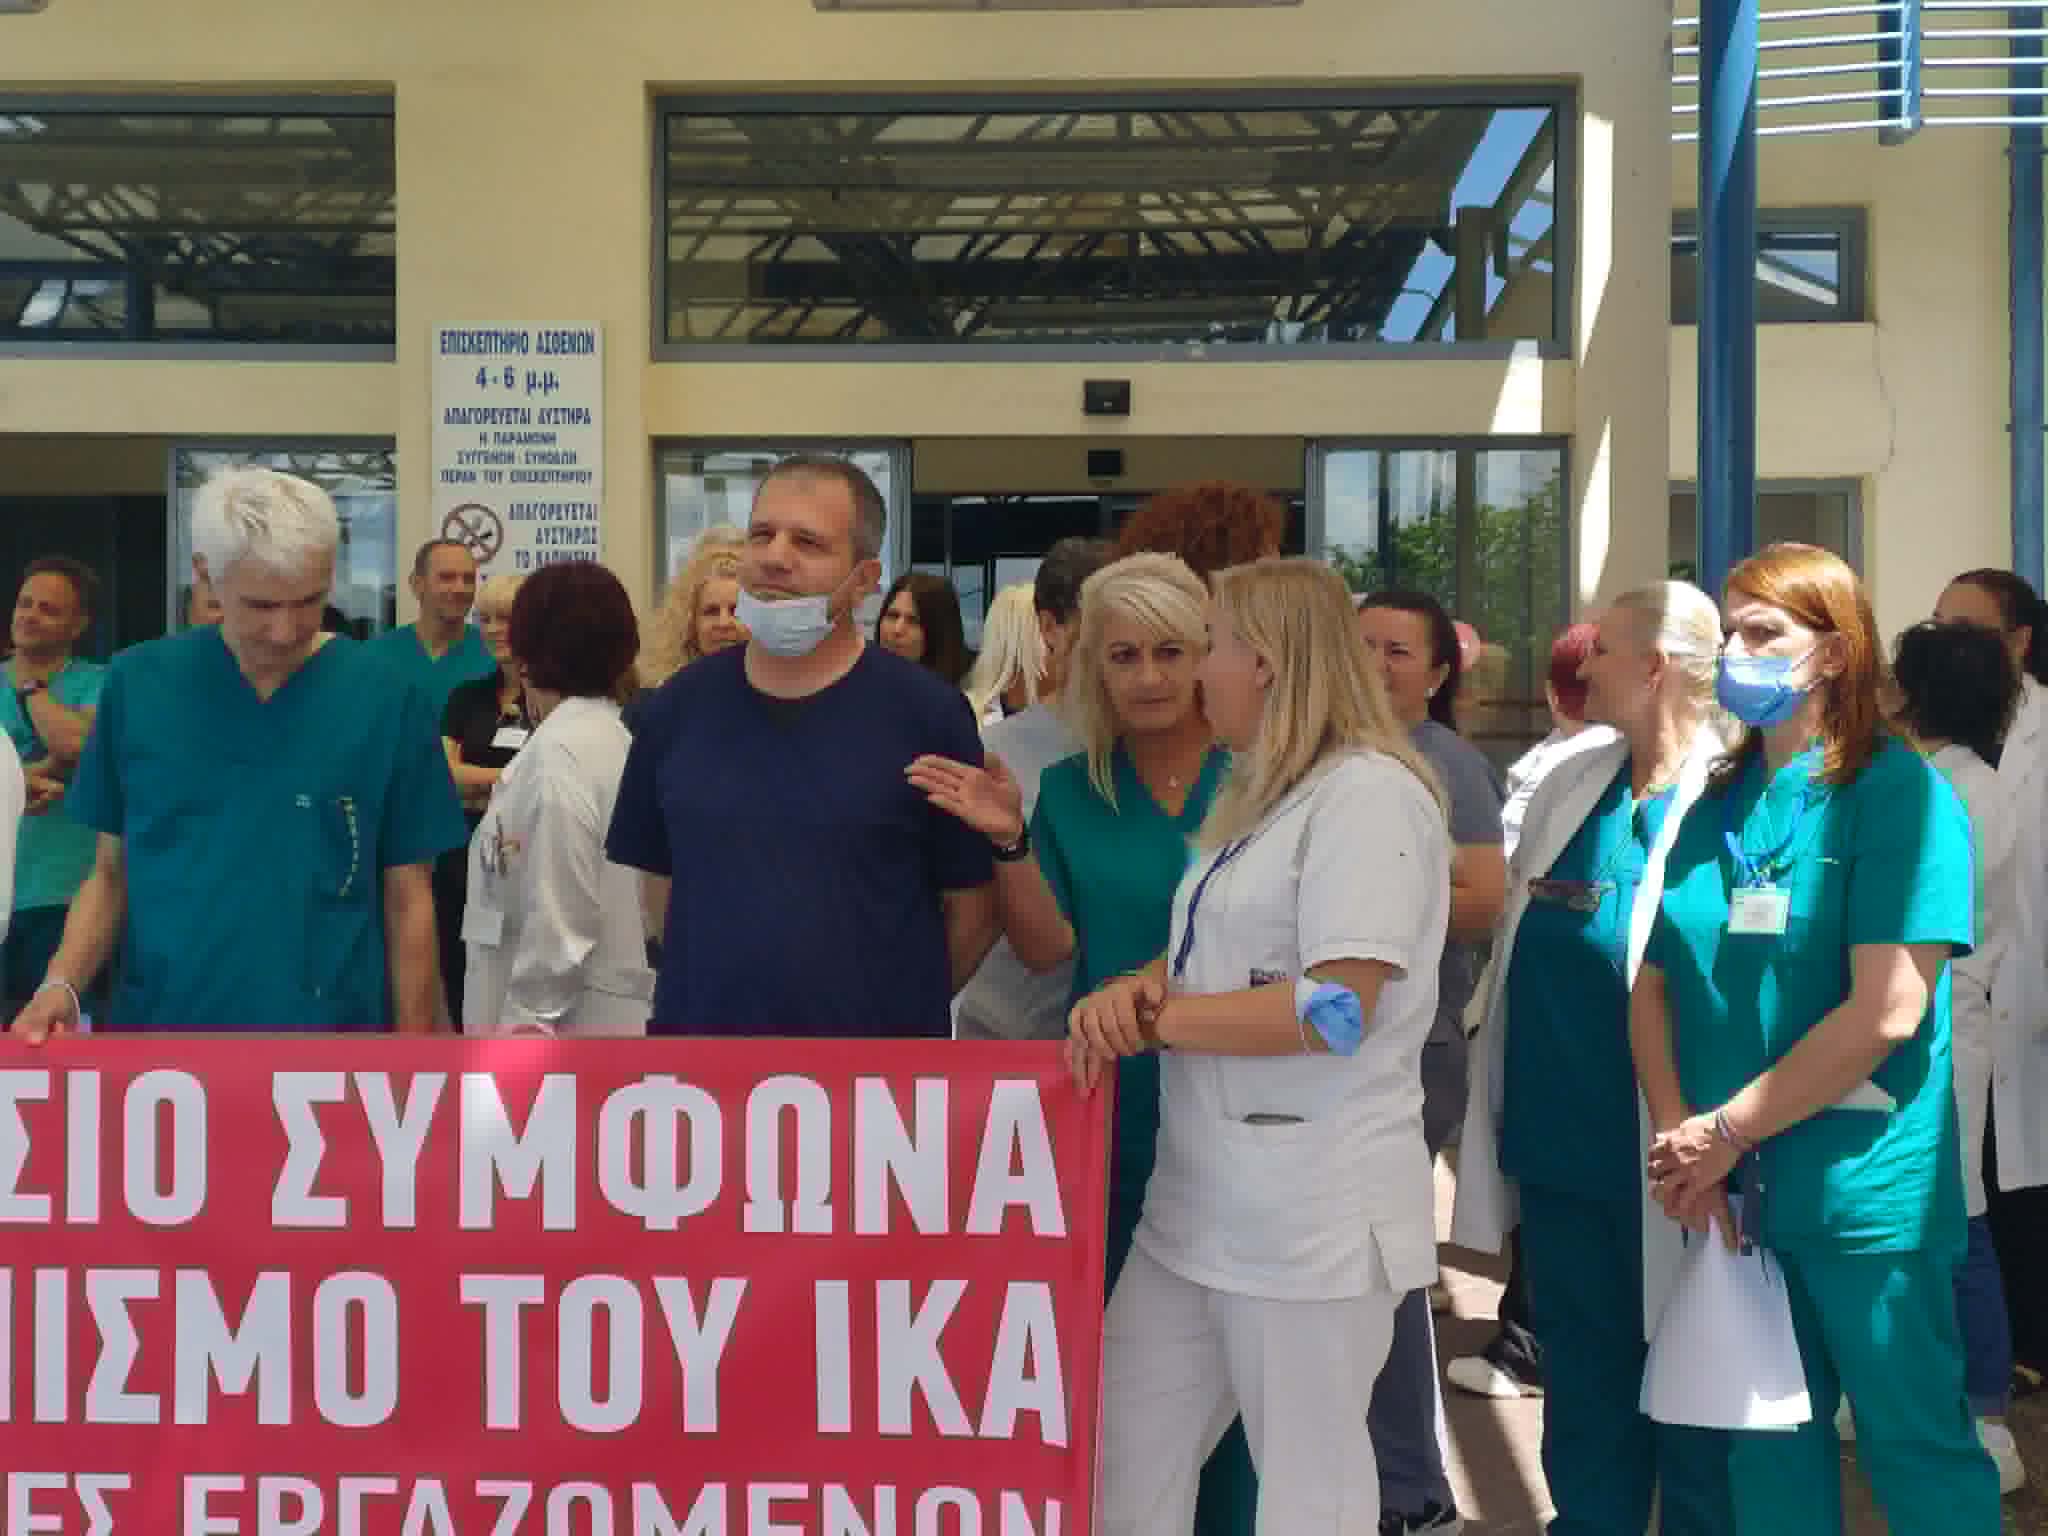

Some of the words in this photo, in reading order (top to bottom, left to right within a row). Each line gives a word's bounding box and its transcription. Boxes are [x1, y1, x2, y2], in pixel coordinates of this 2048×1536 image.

[440, 331, 529, 354] ΕΠΙΣΚΕΠΤΗΡΙΟ
[536, 331, 595, 354] ΑΣΘΕΝΩΝ
[444, 408, 531, 425] ΑΠΑΓΟΡΕΥΕΤΑΙ
[538, 408, 592, 425] ΑΥΣΤΗΡΑ
[483, 470, 504, 484] ΤΟΥ
[509, 503, 598, 521] ΑΠΑΓΟΡΕΥΕΤΑΙ
[0, 1069, 208, 1225] ΣΙΟ
[271, 1071, 1068, 1238] ΣΥΜΦΩΝΑ
[0, 1267, 400, 1428] ΙΣΜΟ
[459, 1274, 750, 1434] ΤΟΥ
[814, 1279, 1069, 1448] ΙΚΑ
